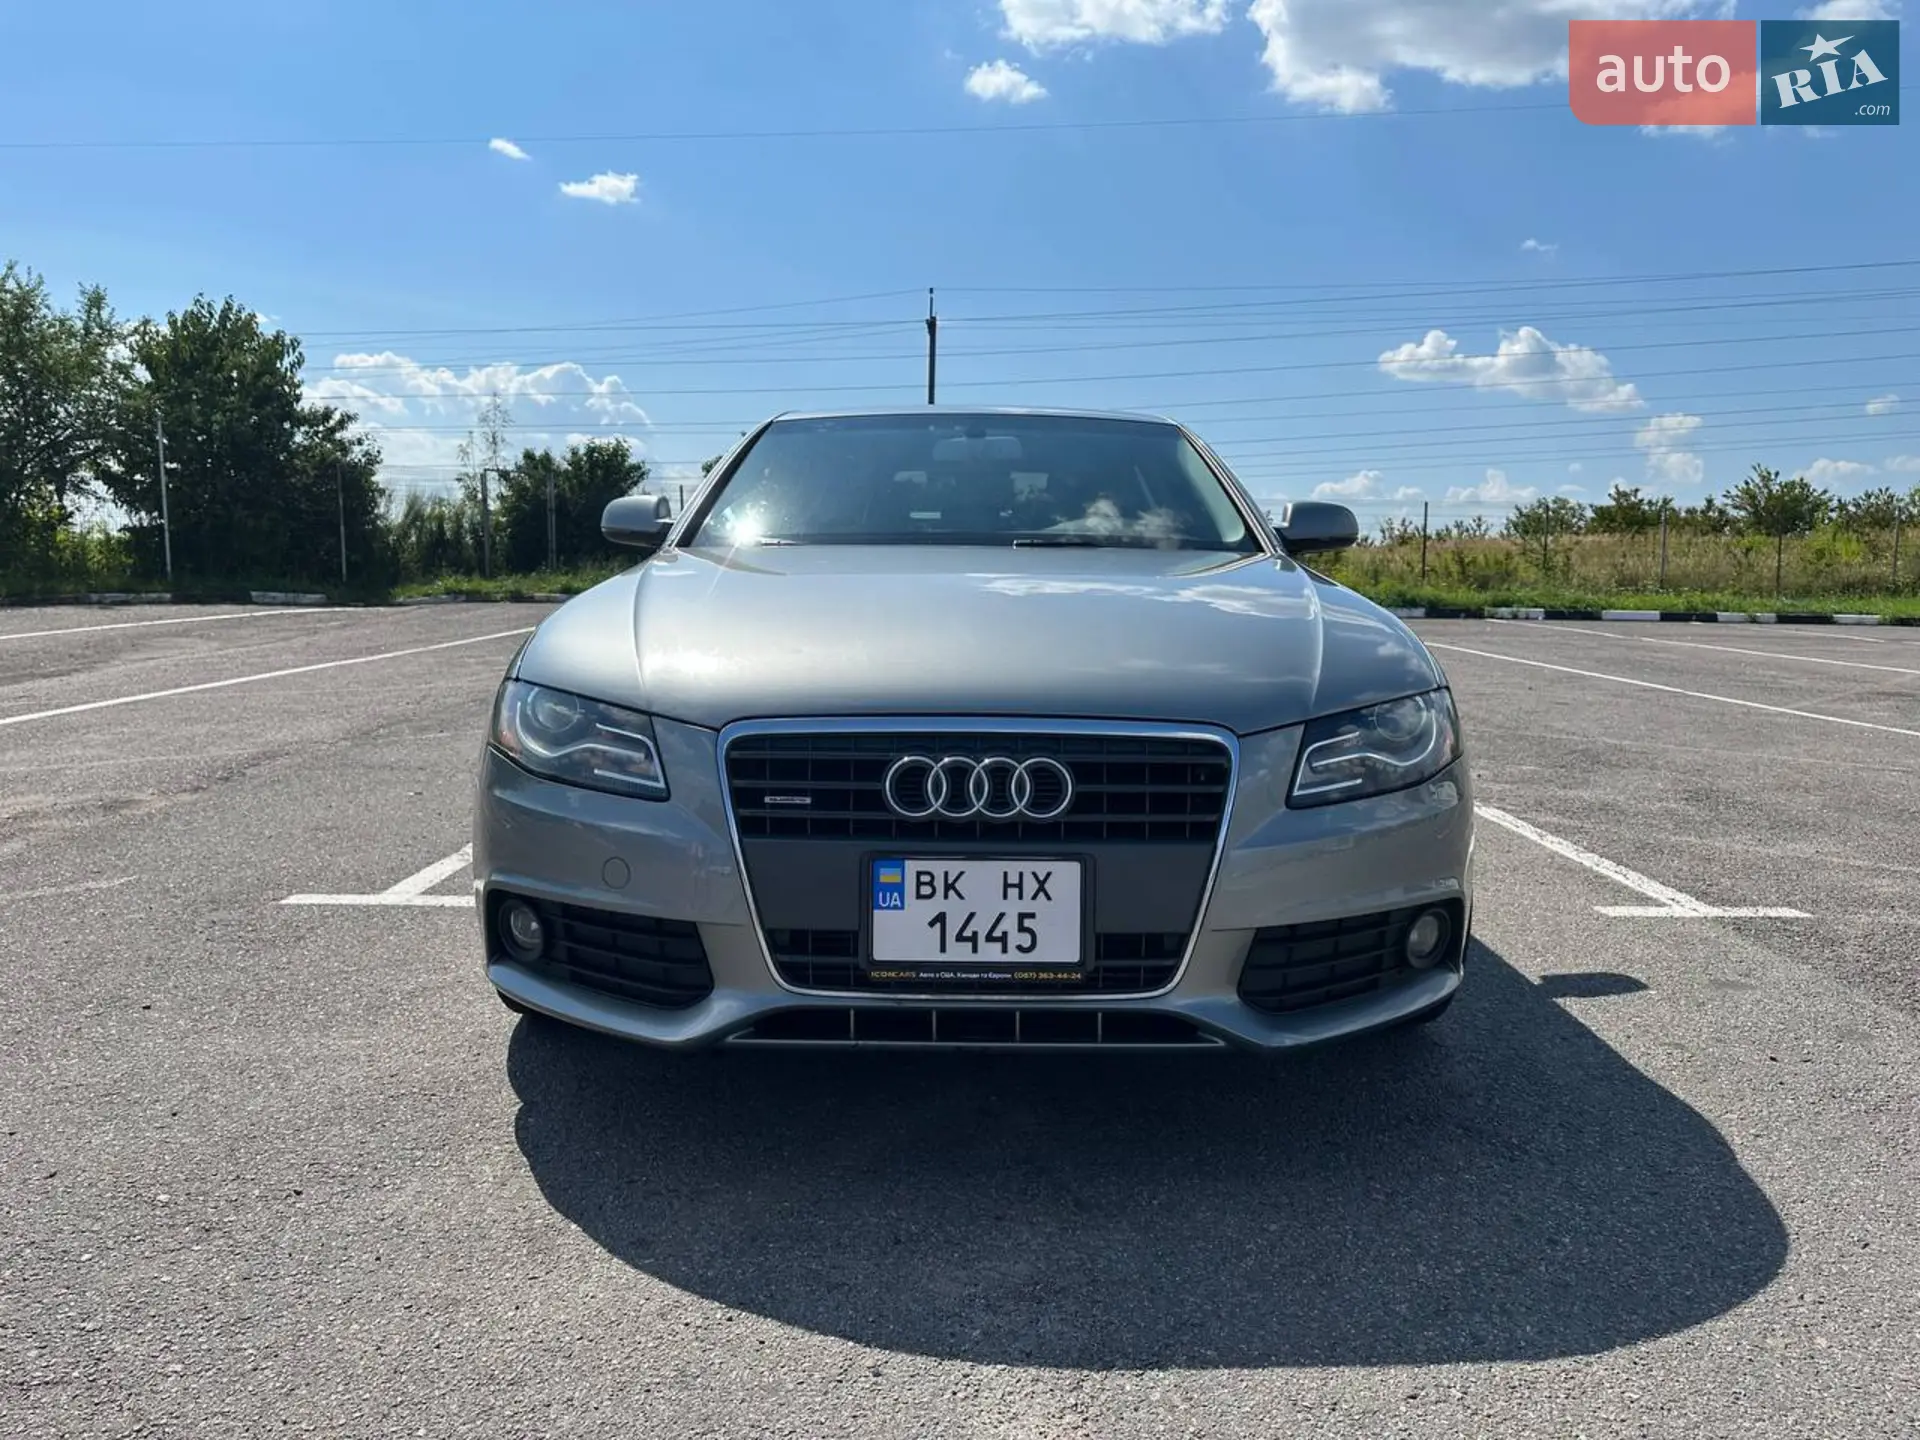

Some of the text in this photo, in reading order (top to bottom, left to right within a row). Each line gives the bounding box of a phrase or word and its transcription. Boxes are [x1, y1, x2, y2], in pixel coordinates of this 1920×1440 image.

[878, 891, 901, 907] UA
[914, 870, 1053, 901] BK HX
[927, 911, 1038, 954] 1445
